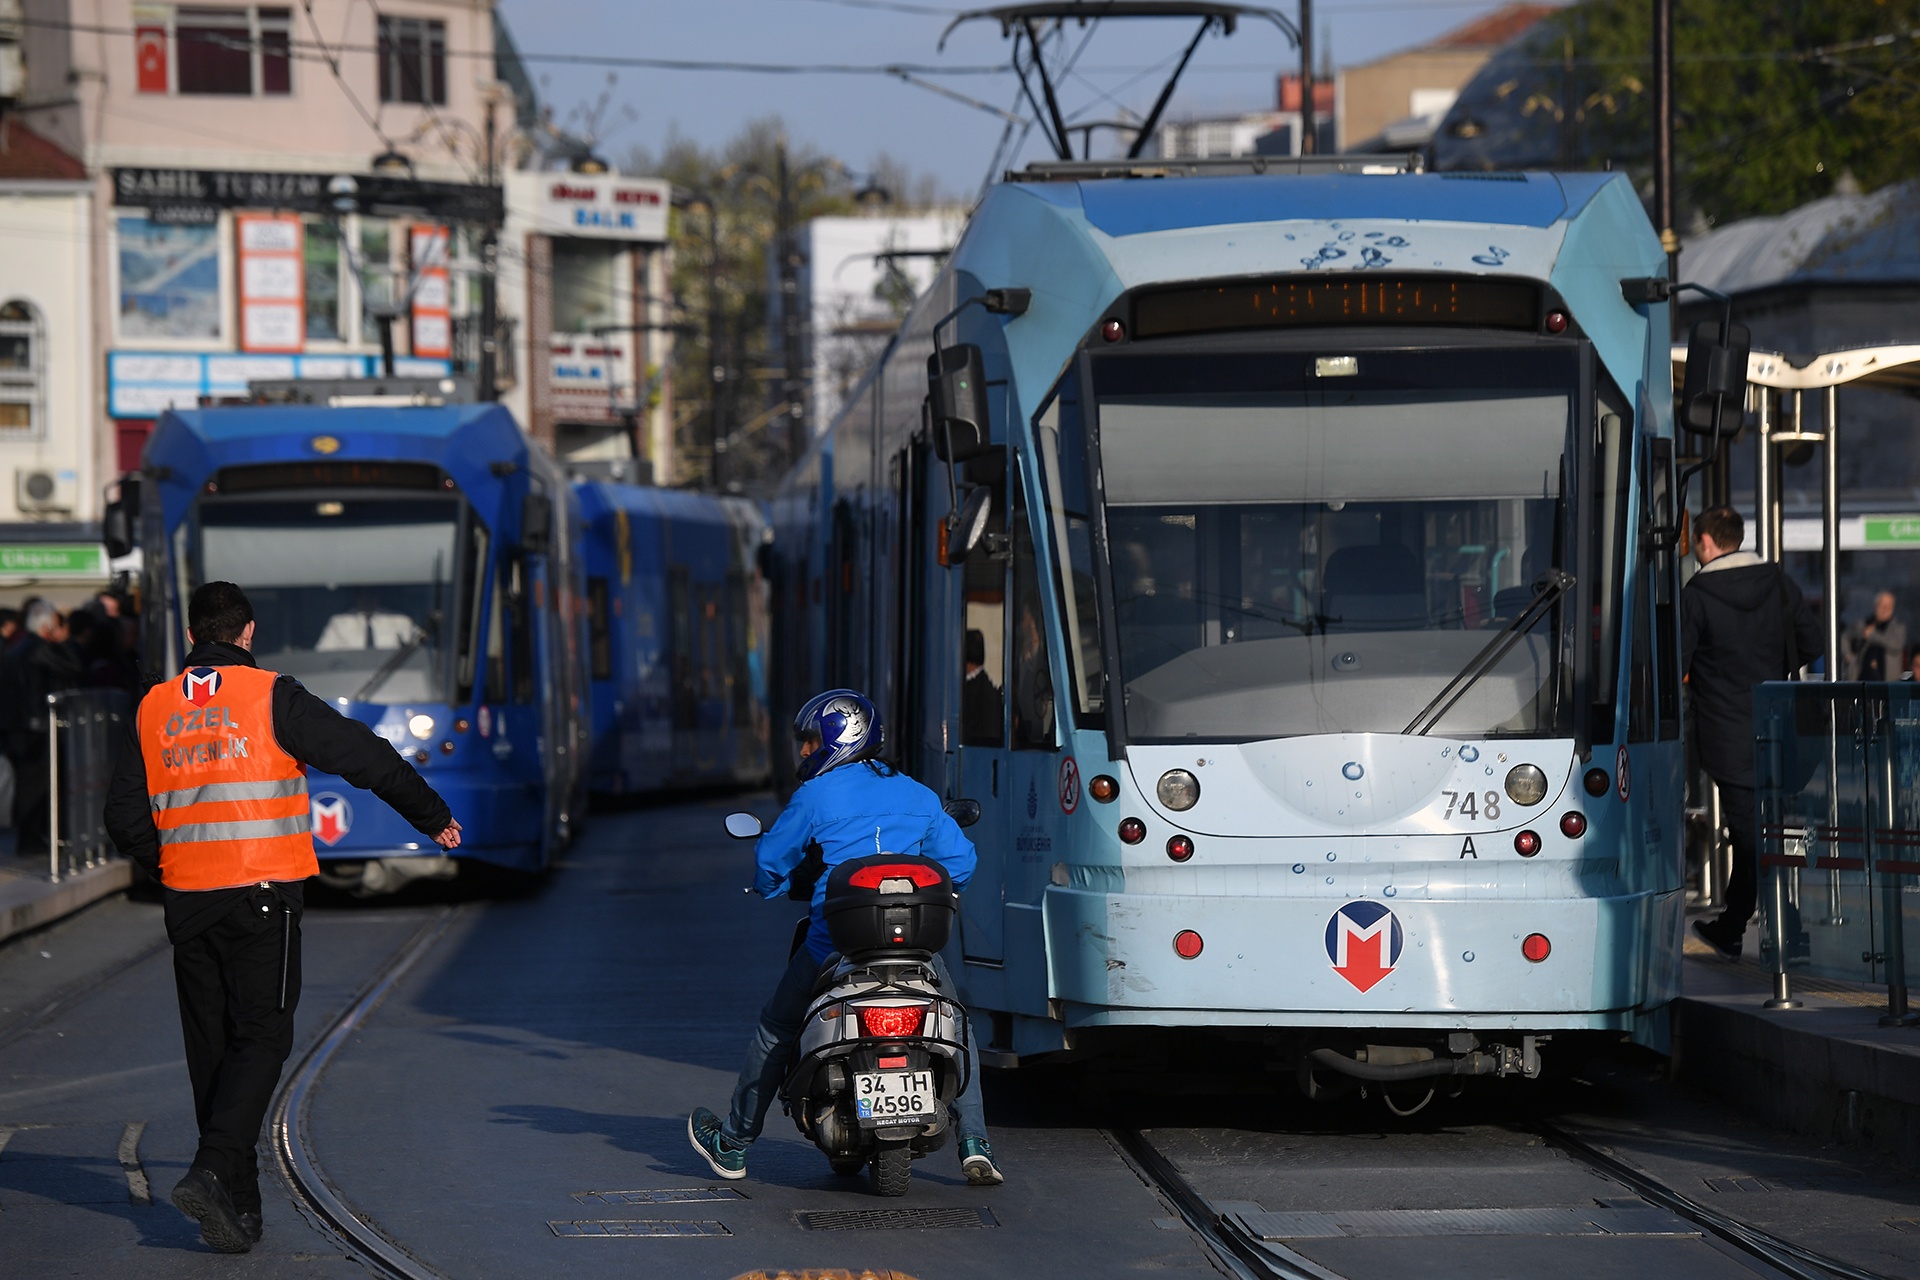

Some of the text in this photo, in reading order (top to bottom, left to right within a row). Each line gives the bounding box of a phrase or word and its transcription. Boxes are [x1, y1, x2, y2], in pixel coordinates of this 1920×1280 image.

[165, 707, 239, 737] ÖZEL
[161, 733, 249, 769] GÜVENLİK
[1441, 790, 1501, 821] 748
[1459, 836, 1478, 859] A
[861, 1074, 928, 1094] 34 TH
[873, 1095, 923, 1114] 4596
